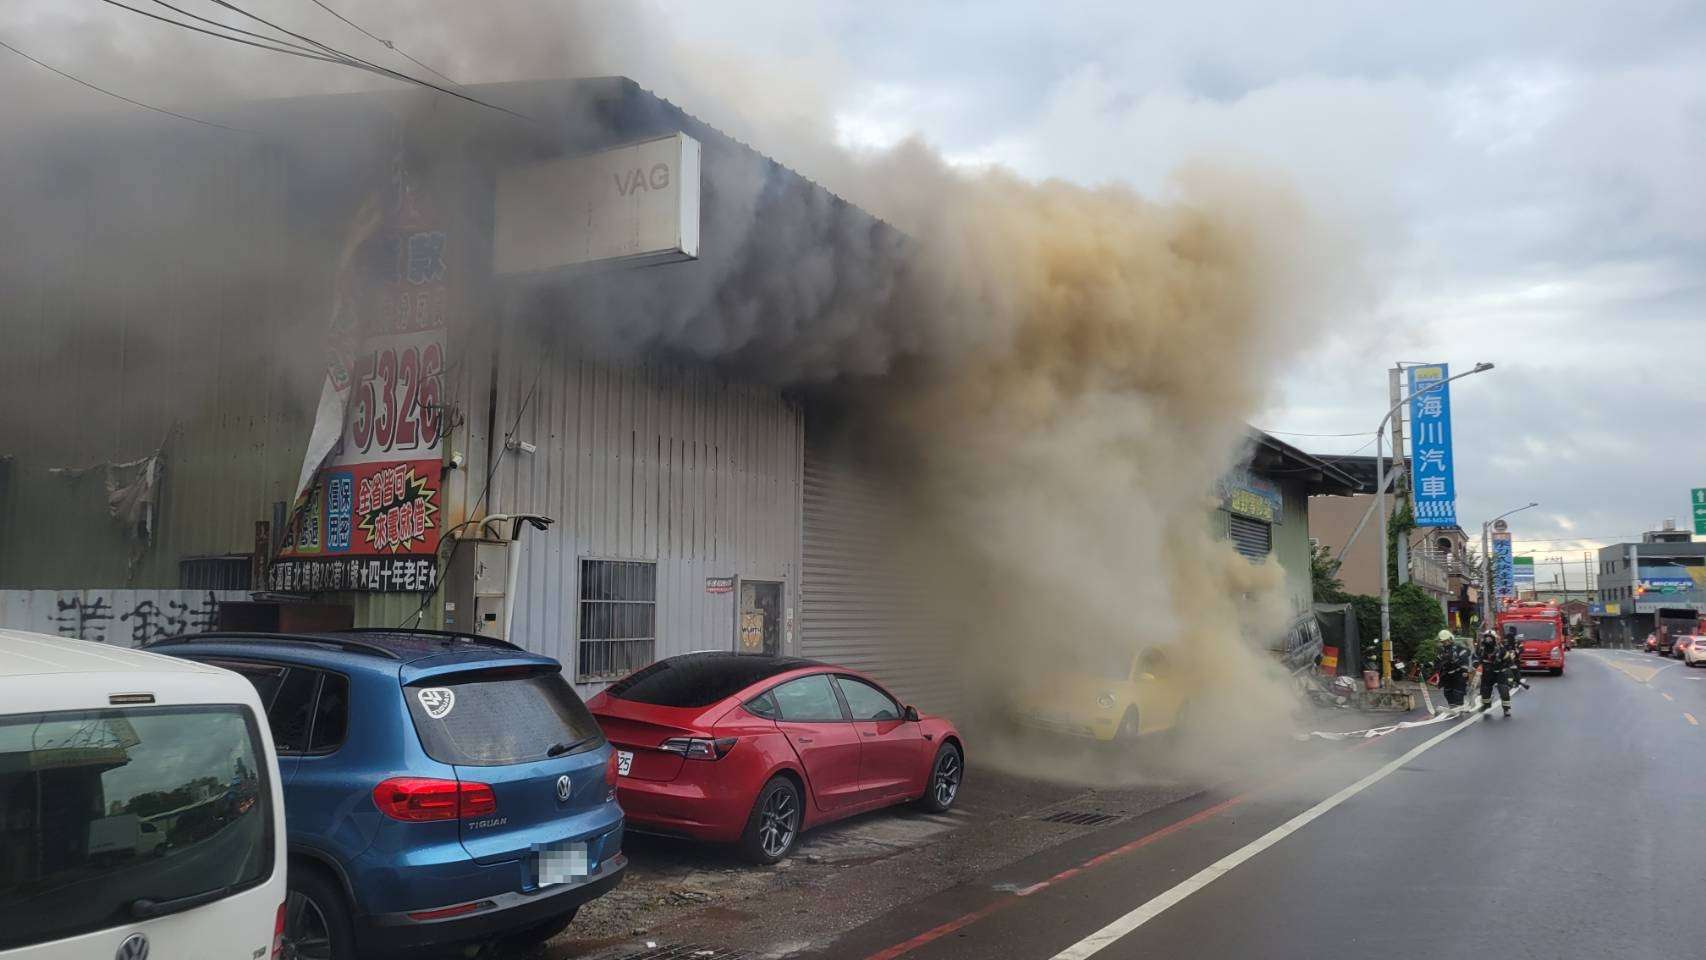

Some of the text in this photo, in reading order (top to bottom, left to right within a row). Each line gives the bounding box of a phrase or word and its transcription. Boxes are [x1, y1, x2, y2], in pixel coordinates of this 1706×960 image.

[613, 162, 669, 196] VAG
[353, 342, 442, 455] 5326
[1417, 394, 1447, 498] 海川汽車
[358, 463, 407, 515] 全省皆可
[374, 497, 427, 549] 來電就借
[468, 818, 508, 830] TIGUAN
